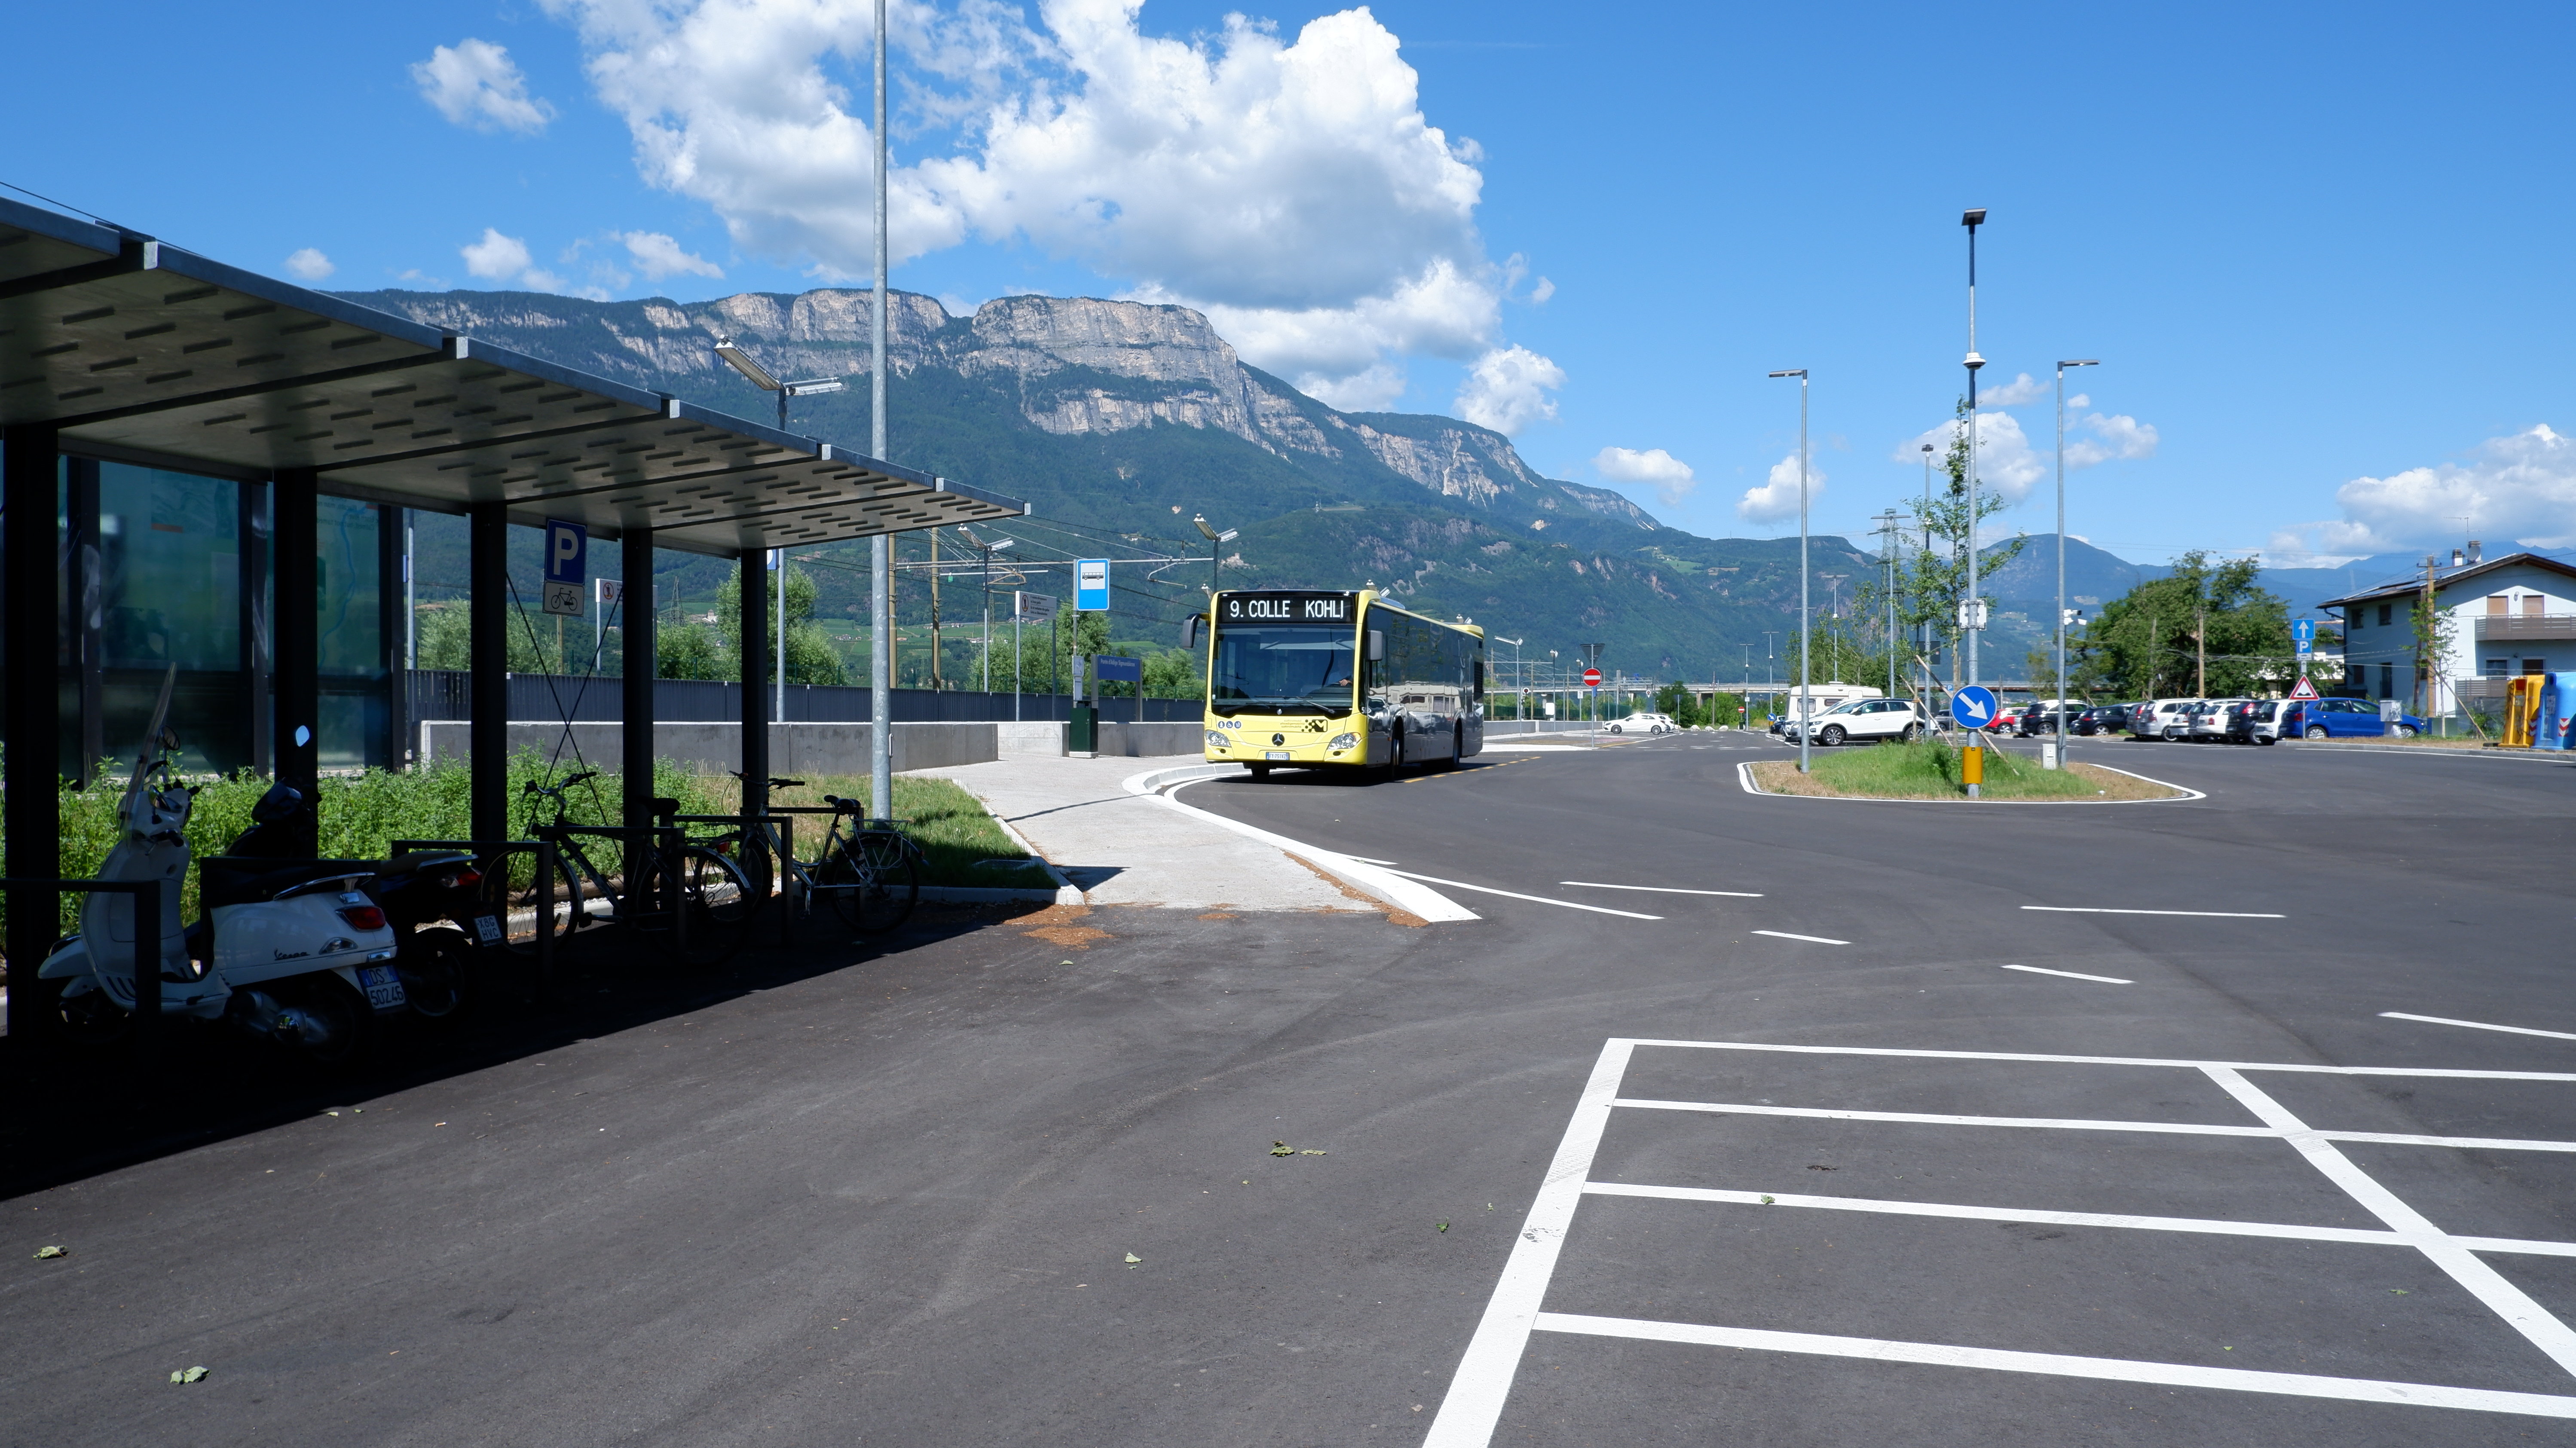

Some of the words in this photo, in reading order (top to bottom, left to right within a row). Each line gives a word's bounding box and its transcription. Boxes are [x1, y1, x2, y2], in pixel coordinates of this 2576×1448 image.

[554, 527, 578, 575] P
[1230, 600, 1244, 618] 9.
[1249, 600, 1290, 618] COLLE
[2299, 641, 2309, 652] P
[482, 928, 499, 939] HVC
[274, 948, 310, 961] Vespa
[368, 968, 385, 984] DS
[370, 985, 404, 1005] 50246
